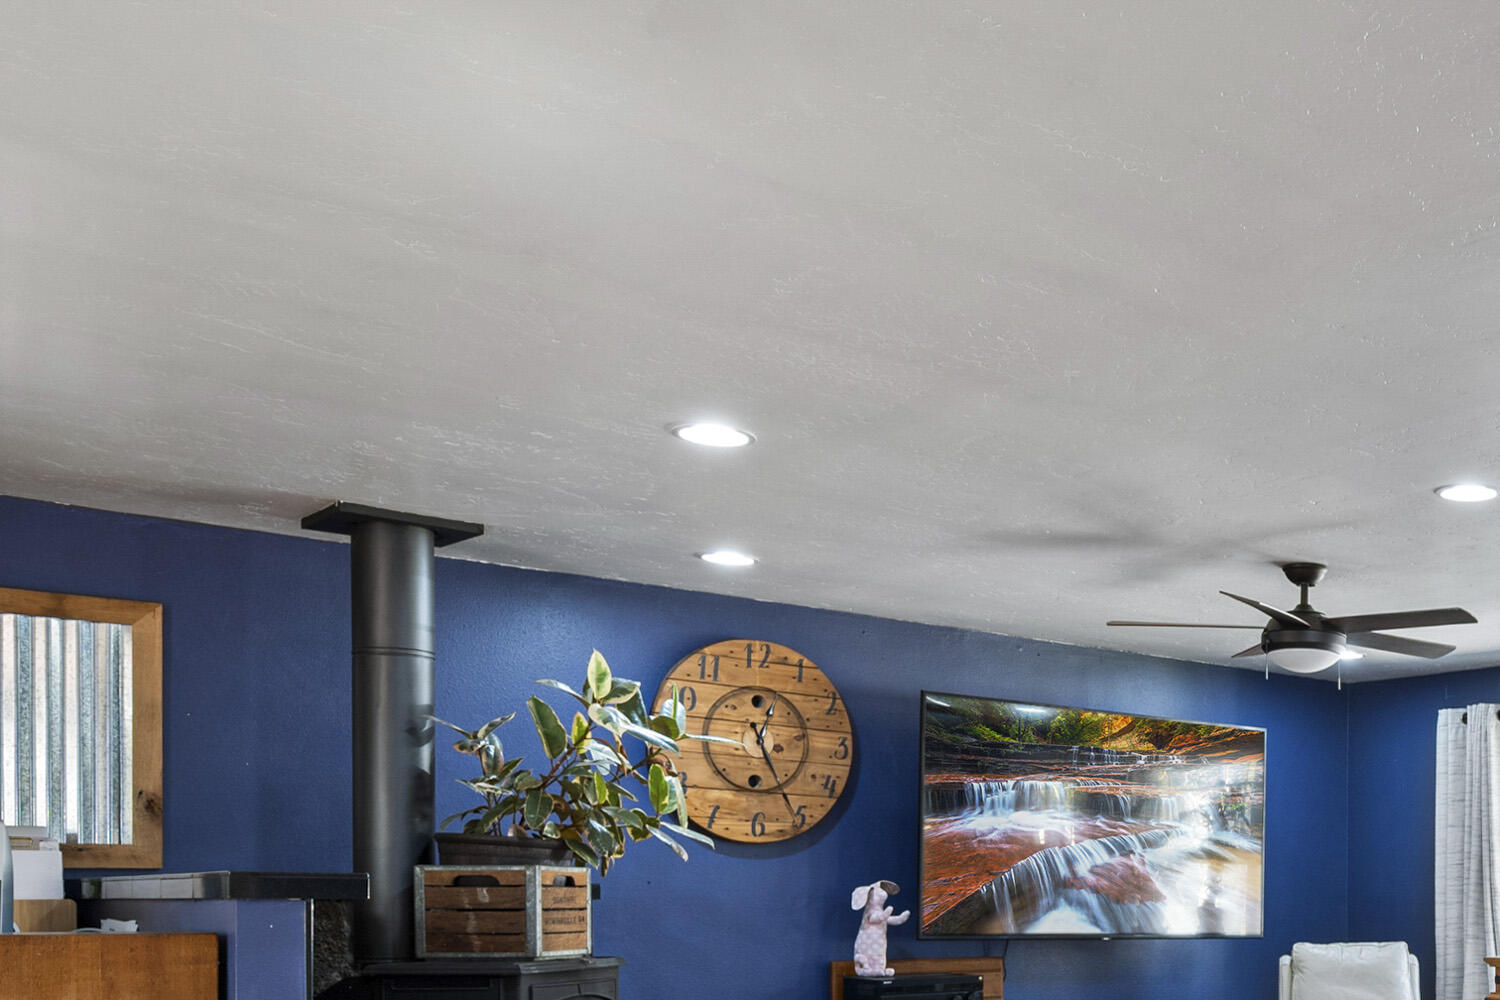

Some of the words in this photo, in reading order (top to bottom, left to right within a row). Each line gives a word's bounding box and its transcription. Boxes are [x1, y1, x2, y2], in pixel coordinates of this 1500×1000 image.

[697, 653, 721, 682] 11
[743, 643, 772, 669] 12
[795, 659, 804, 683] 1
[825, 691, 838, 716] 2
[834, 736, 849, 760] 3
[823, 774, 837, 799] 4
[706, 804, 721, 829] 7
[751, 811, 766, 838] 6
[791, 805, 807, 829] 5
